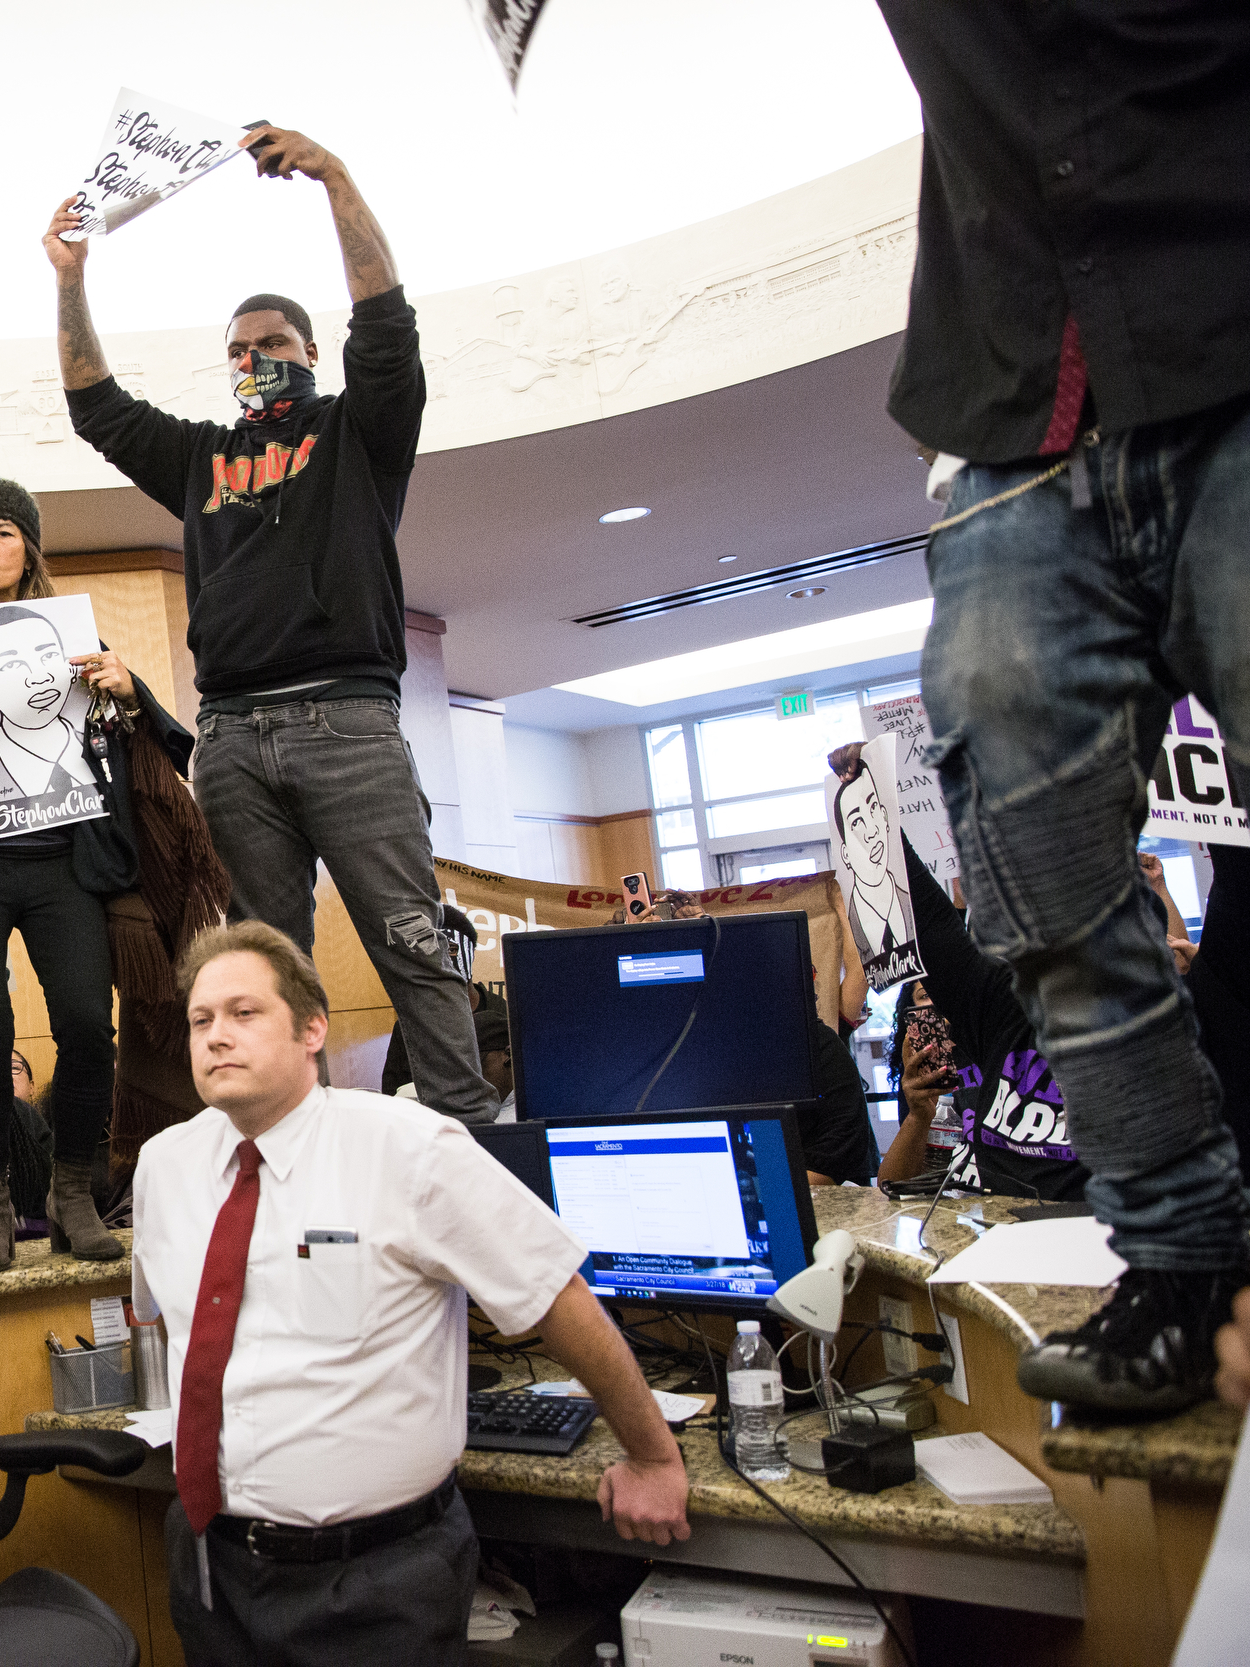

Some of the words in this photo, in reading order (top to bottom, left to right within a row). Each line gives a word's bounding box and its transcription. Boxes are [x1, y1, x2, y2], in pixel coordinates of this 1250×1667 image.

[114, 108, 192, 164] #Stephon
[781, 693, 808, 716] EXIT
[1193, 813, 1218, 826] NOT
[1224, 816, 1233, 826] A
[449, 863, 469, 875] HIS
[471, 870, 508, 884] NAME
[567, 889, 625, 909] Lon
[1006, 1141, 1047, 1157] MOVEMENT,
[618, 1256, 626, 1264] An
[625, 1257, 640, 1266] Open
[640, 1257, 669, 1266] Community
[669, 1258, 693, 1267] Dialogue
[632, 1265, 663, 1273] Sacramento
[663, 1266, 674, 1275] City
[674, 1266, 694, 1274] Council
[615, 1275, 645, 1284] Sacramento
[645, 1276, 656, 1286] City
[656, 1277, 676, 1286] Council
[705, 1280, 726, 1289] 3/27/18
[720, 1652, 754, 1666] EPSON
